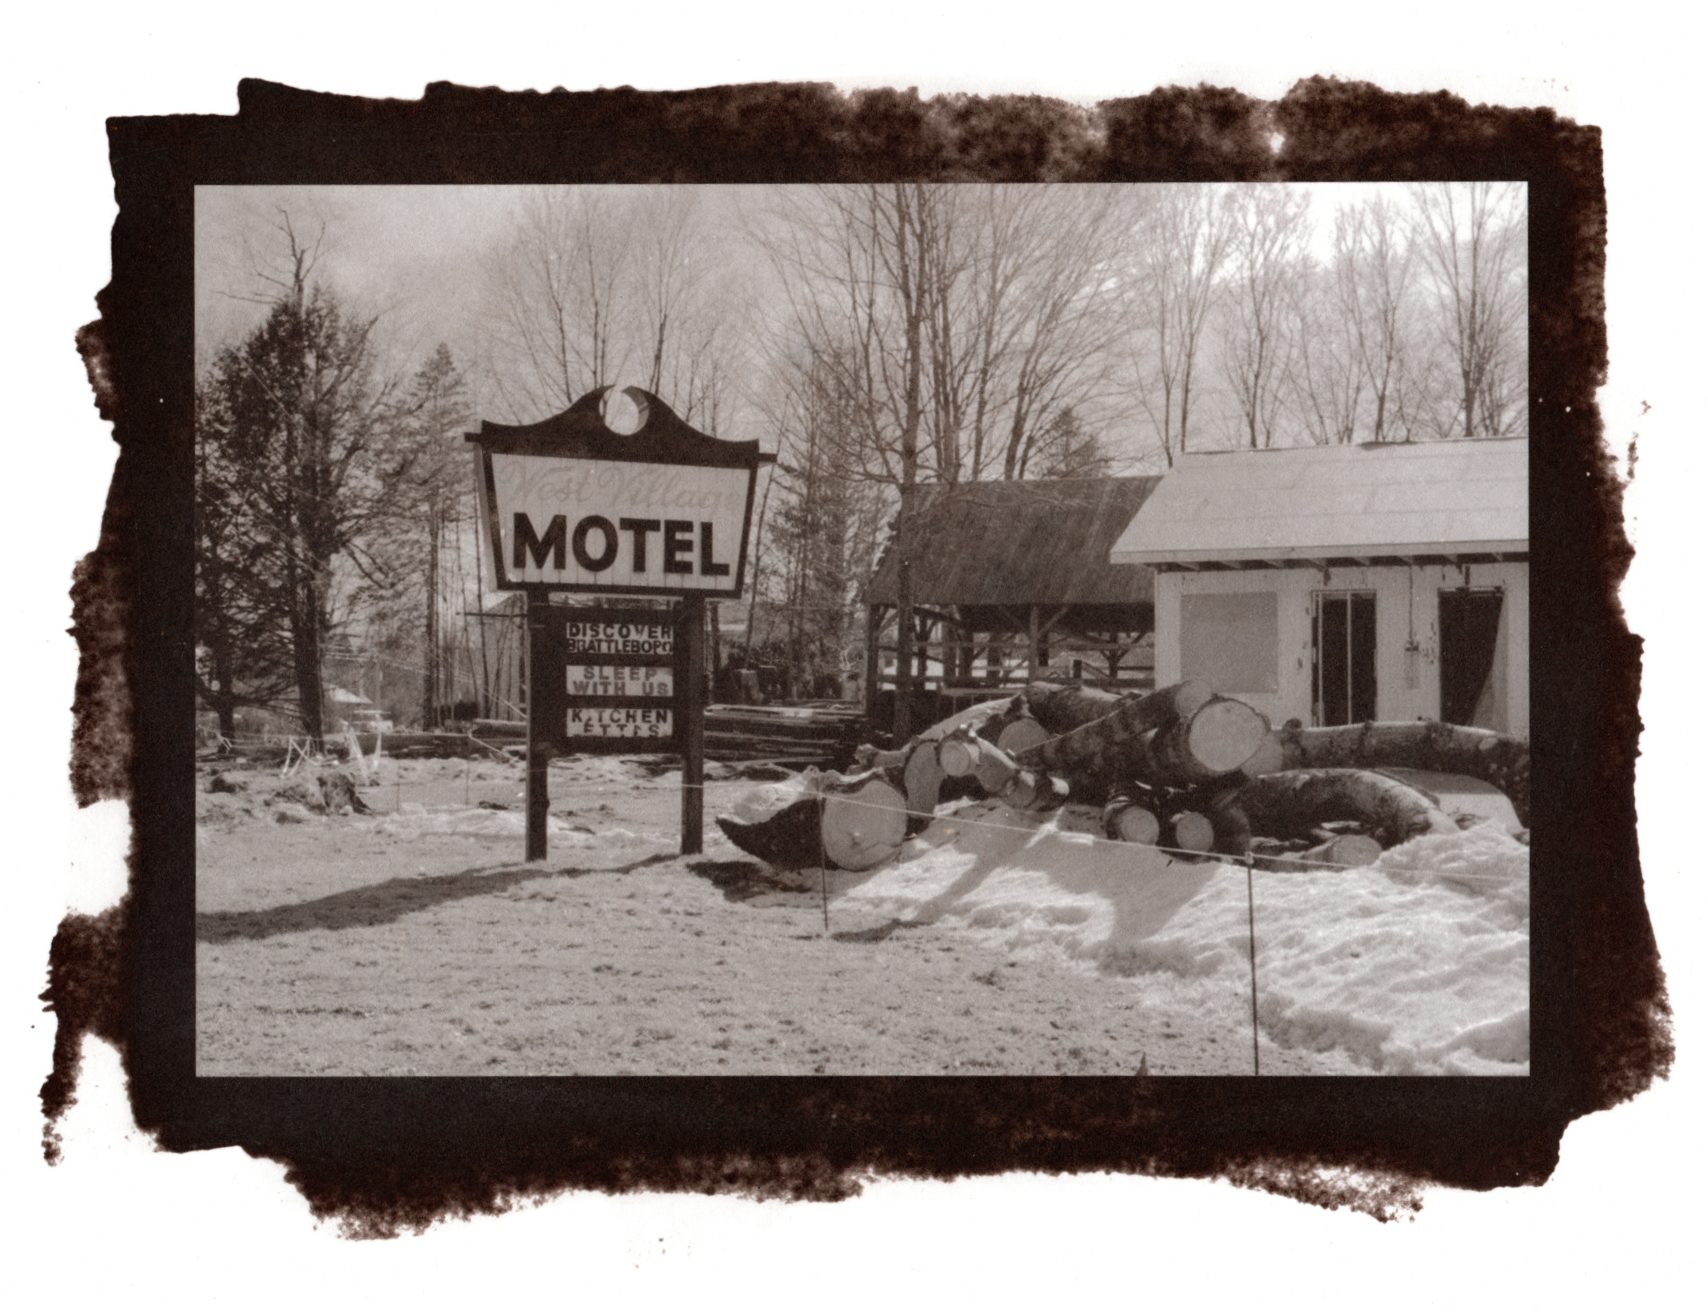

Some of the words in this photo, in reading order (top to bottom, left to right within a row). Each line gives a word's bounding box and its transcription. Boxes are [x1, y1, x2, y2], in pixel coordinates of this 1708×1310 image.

[498, 460, 593, 505] West
[596, 465, 741, 517] Village
[512, 511, 731, 577] MOTEL
[568, 622, 673, 640] DISCOVER
[583, 666, 657, 681] SLEEP
[573, 681, 626, 696] WITH
[642, 682, 669, 697] US
